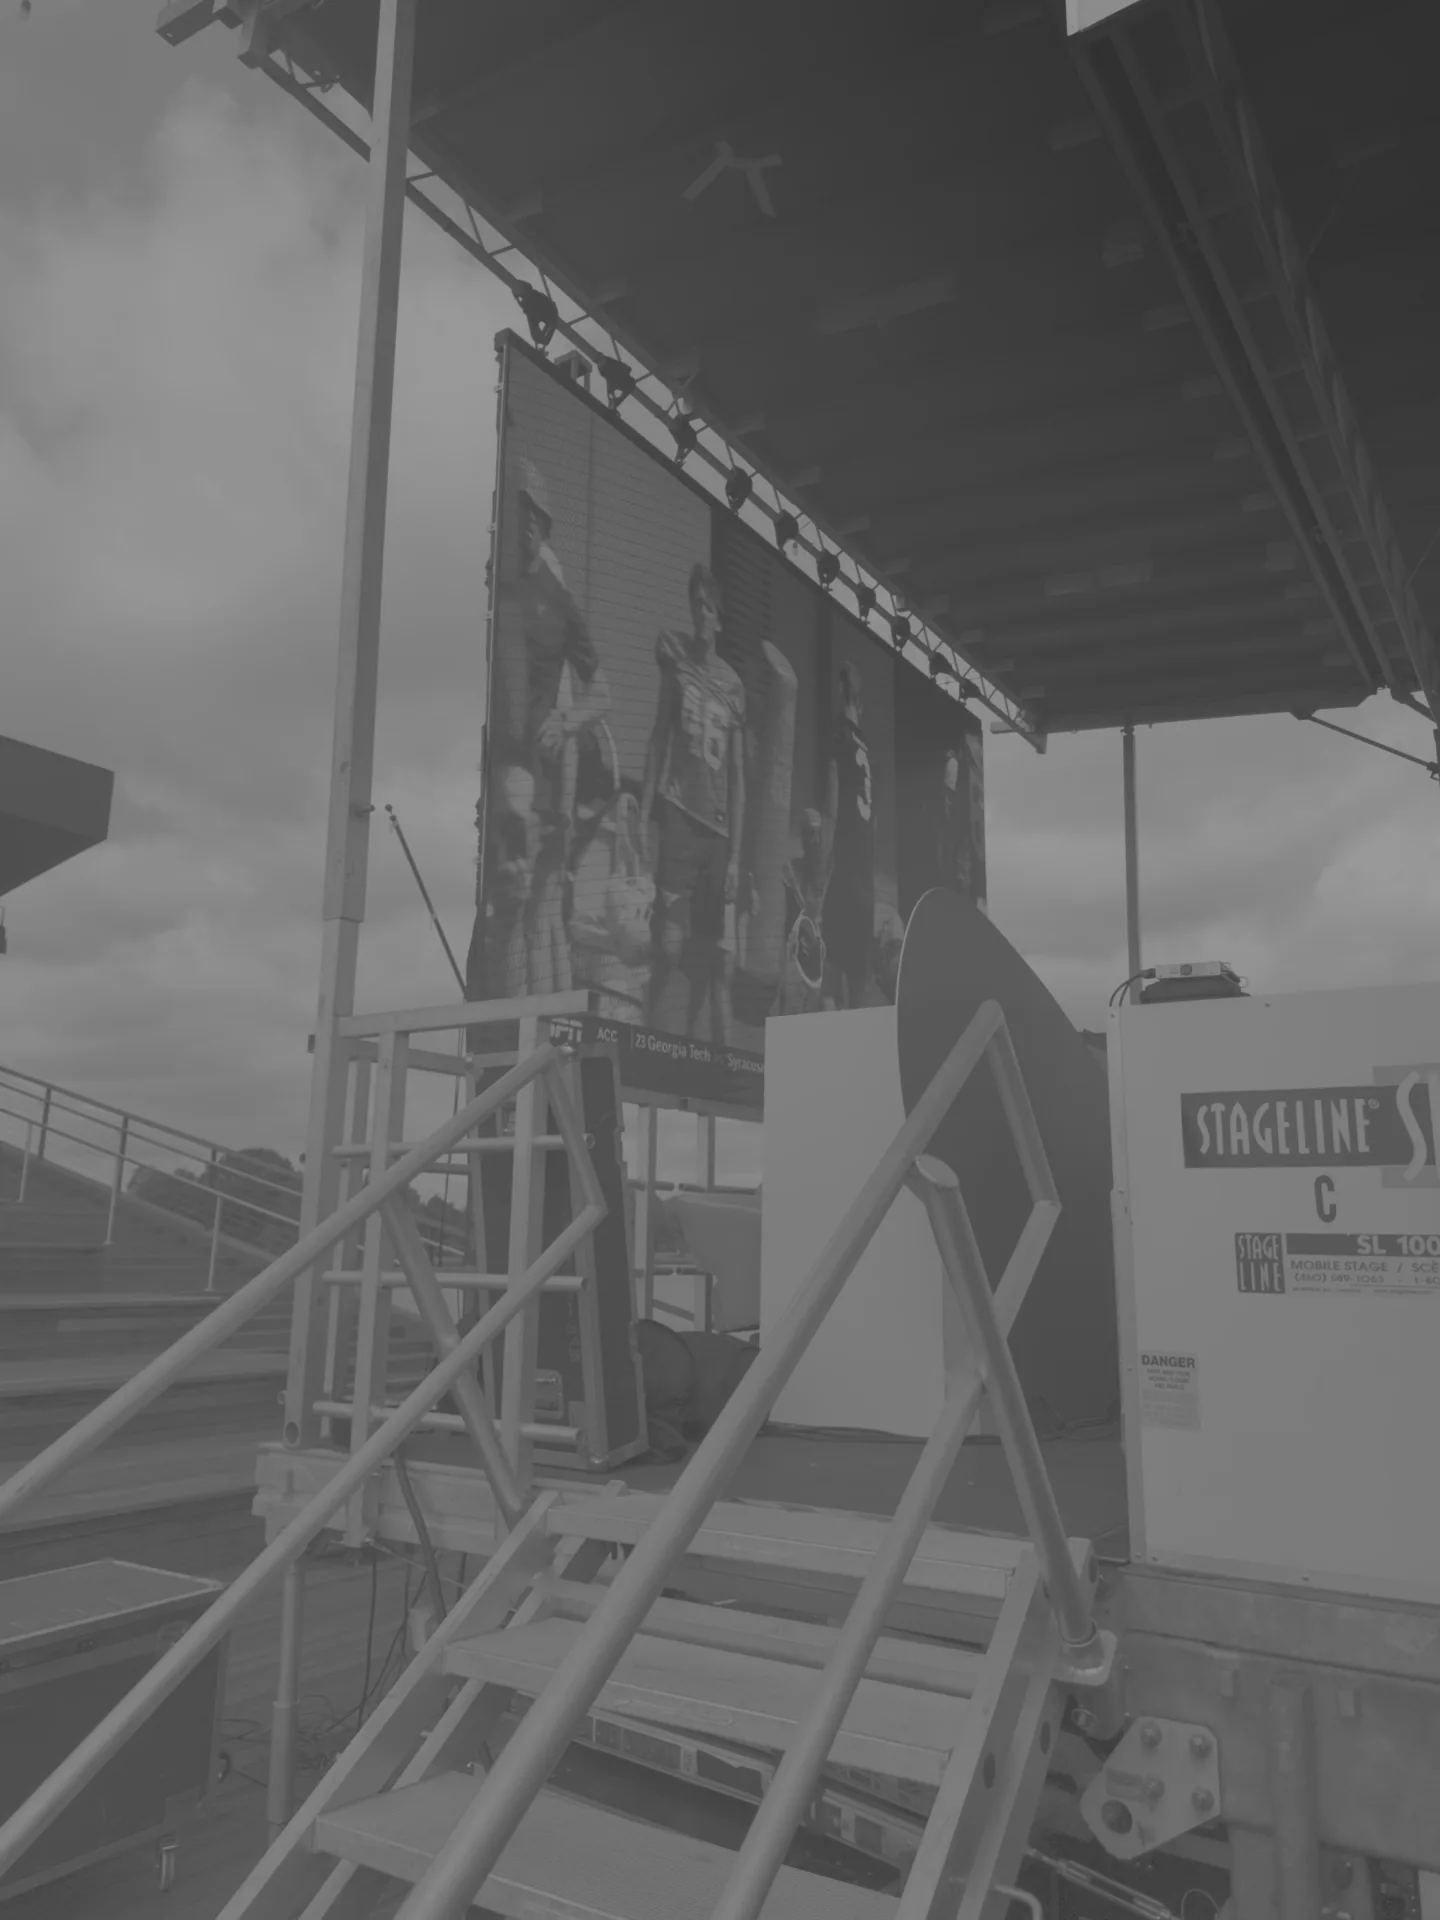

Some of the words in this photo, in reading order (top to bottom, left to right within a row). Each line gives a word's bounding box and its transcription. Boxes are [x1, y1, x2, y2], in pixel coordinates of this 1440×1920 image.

[597, 1026, 618, 1043] ACC
[635, 1033, 646, 1049] 23
[648, 1035, 687, 1060] Georgia
[689, 1043, 711, 1063] Tech
[1313, 1173, 1337, 1224] C
[1237, 1234, 1280, 1260] STAGE
[1356, 1234, 1387, 1256] SL
[1239, 1261, 1282, 1292] LINE
[1291, 1260, 1341, 1271] MOBILE
[1343, 1261, 1388, 1273] STAGE
[1141, 1353, 1195, 1369] DANGER
